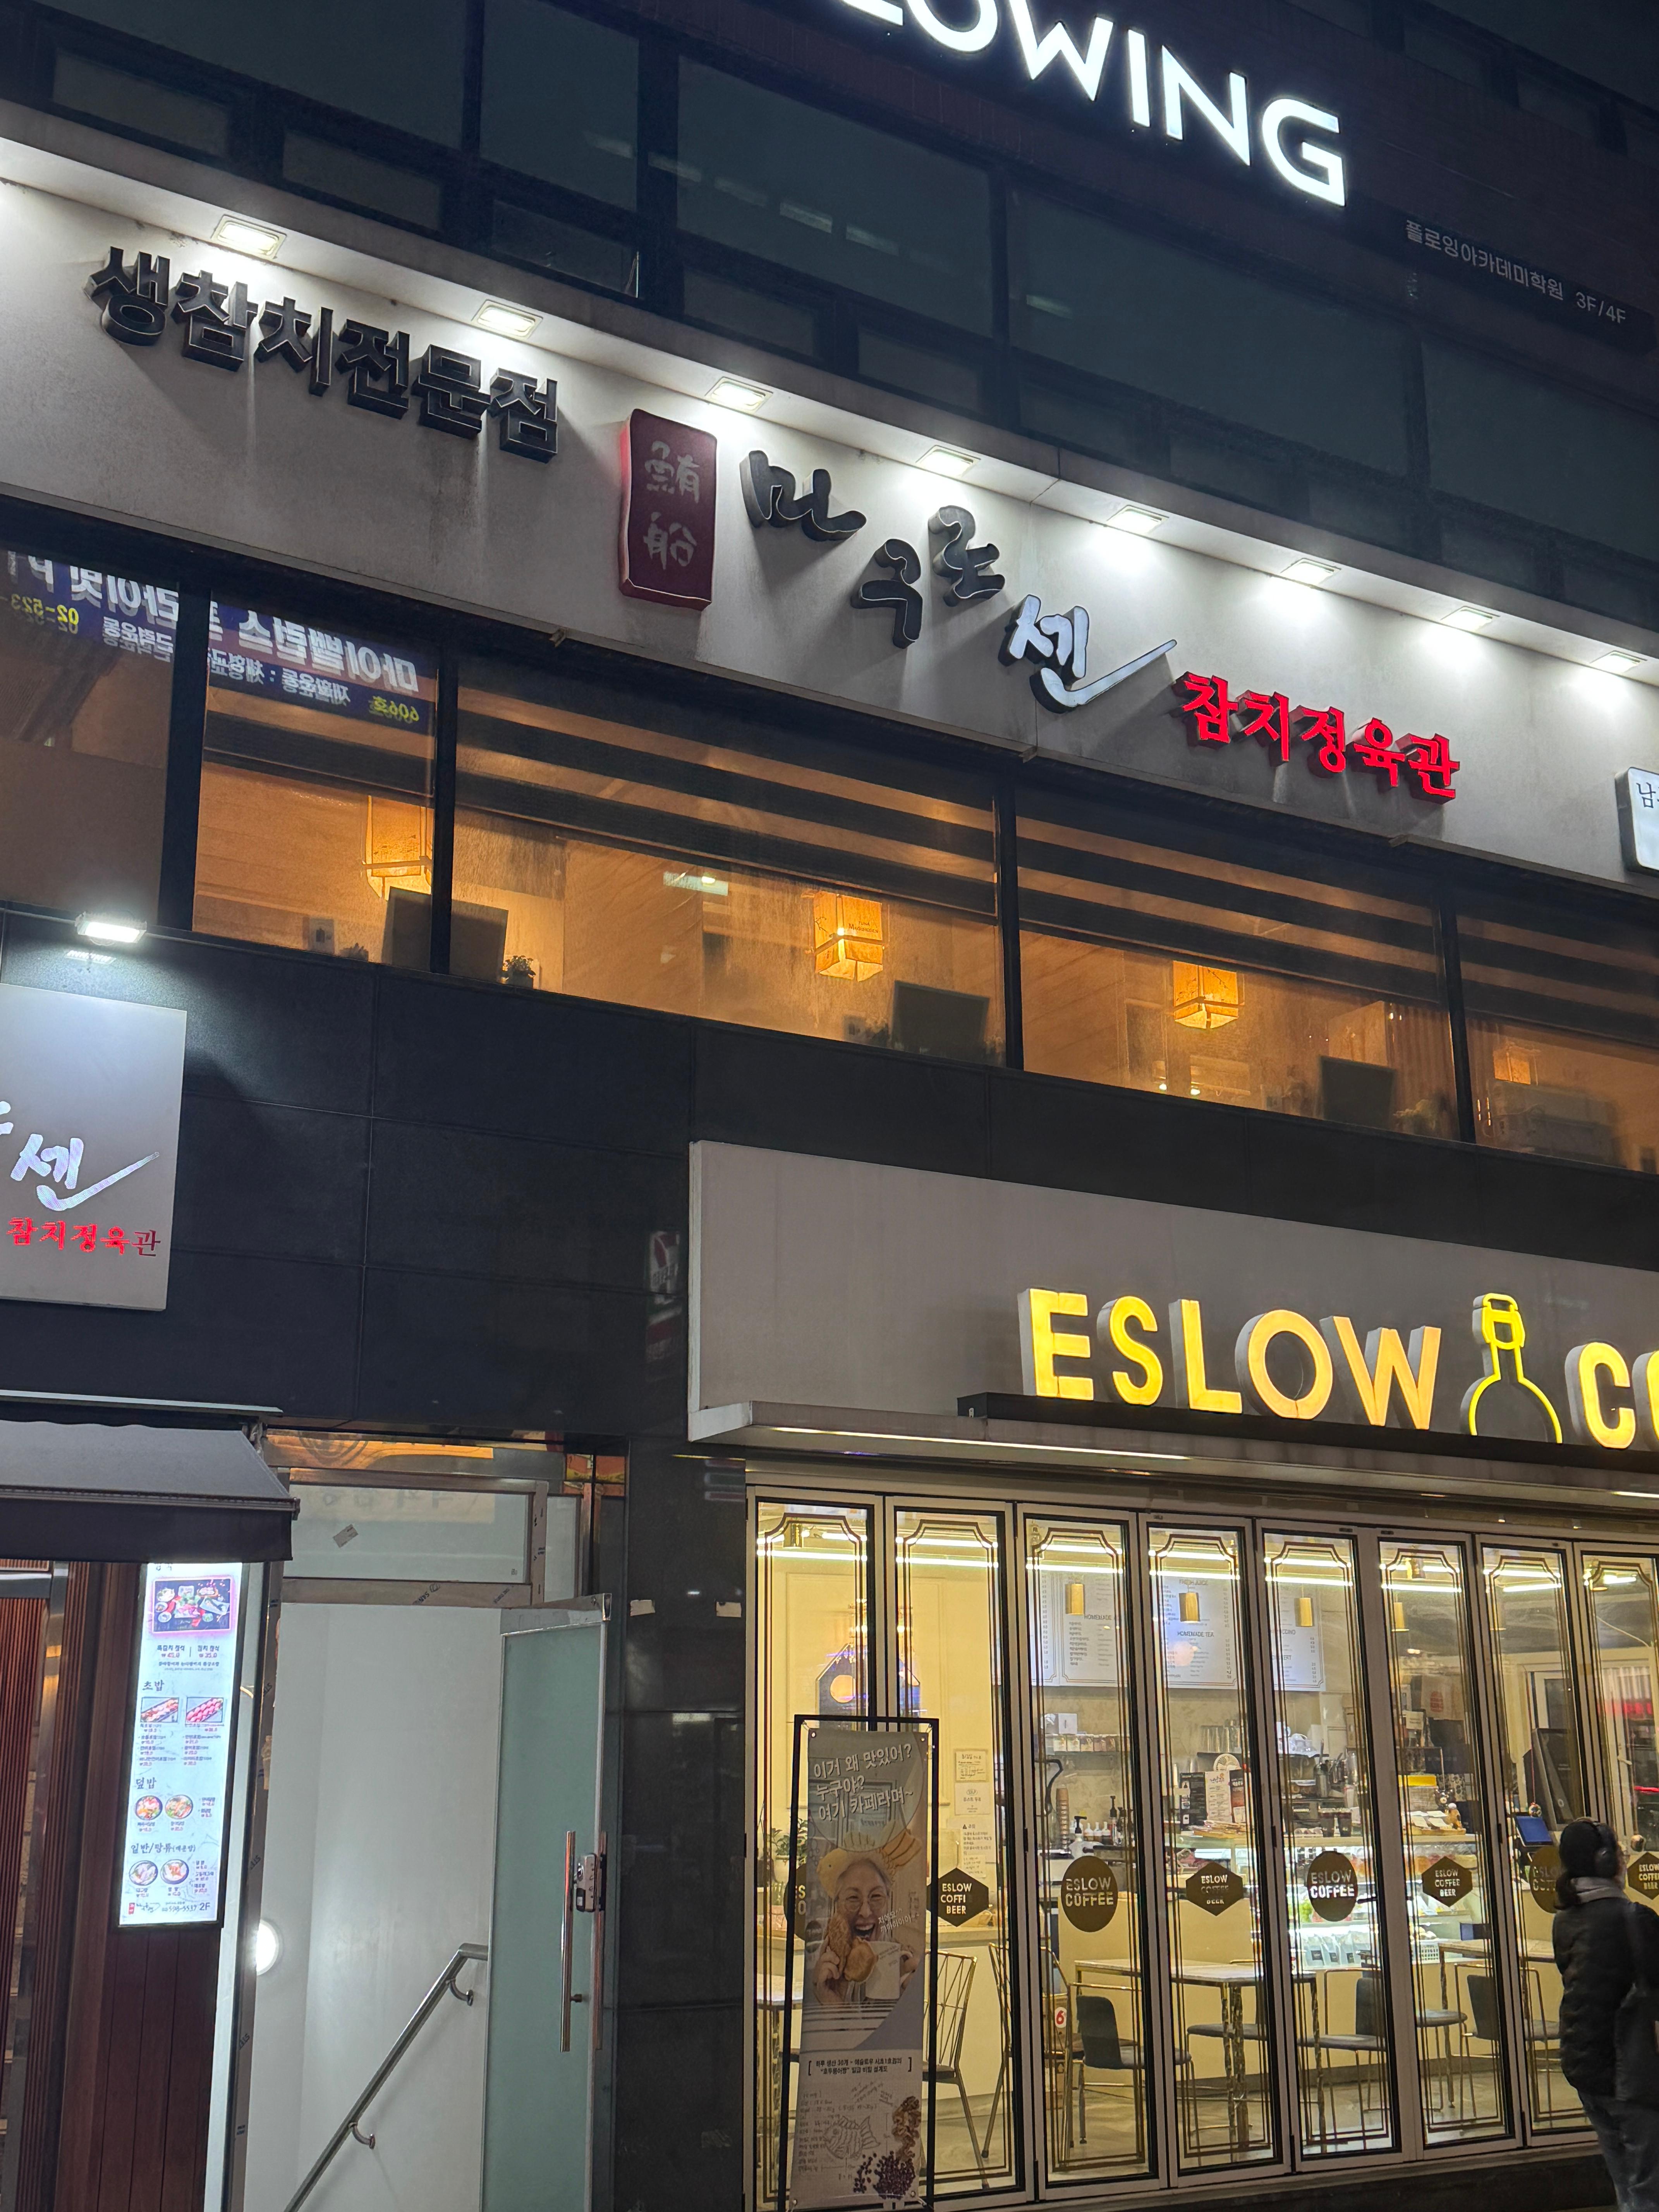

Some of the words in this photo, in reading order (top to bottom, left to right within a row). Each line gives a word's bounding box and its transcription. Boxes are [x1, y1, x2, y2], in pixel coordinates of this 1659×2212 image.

[1405, 220, 1564, 301] 플로잉아카데미학원
[1576, 292, 1626, 324] 3F/4F
[83, 245, 558, 463] 생참치전문점
[1171, 671, 1461, 804] 참치정육관
[6, 1217, 161, 1257] 참치정육관
[1018, 1288, 1442, 1430] ESLOW
[1565, 1341, 1659, 1449] C
[814, 1757, 841, 1779] 이거
[845, 1754, 860, 1772] 왜
[863, 1743, 912, 1769] 맛있어?
[816, 1775, 866, 1801] 누구야?
[818, 1800, 846, 1821] 여기
[851, 1786, 914, 1814] 카페라며~
[1201, 1875, 1228, 1884] ESLOW
[1310, 1870, 1352, 1884] ESLOW
[1435, 1868, 1459, 1878] ESLOW
[942, 1883, 972, 1893] ESLOW
[1065, 1877, 1111, 1892] ESLOW
[1434, 1878, 1460, 1887] COFFEE
[1065, 1891, 1114, 1907] COFFEE
[1309, 1885, 1355, 1899] COFFEE
[1439, 1889, 1456, 1898] BEER
[199, 1902, 211, 1911] 2F
[946, 1905, 967, 1915] BEER
